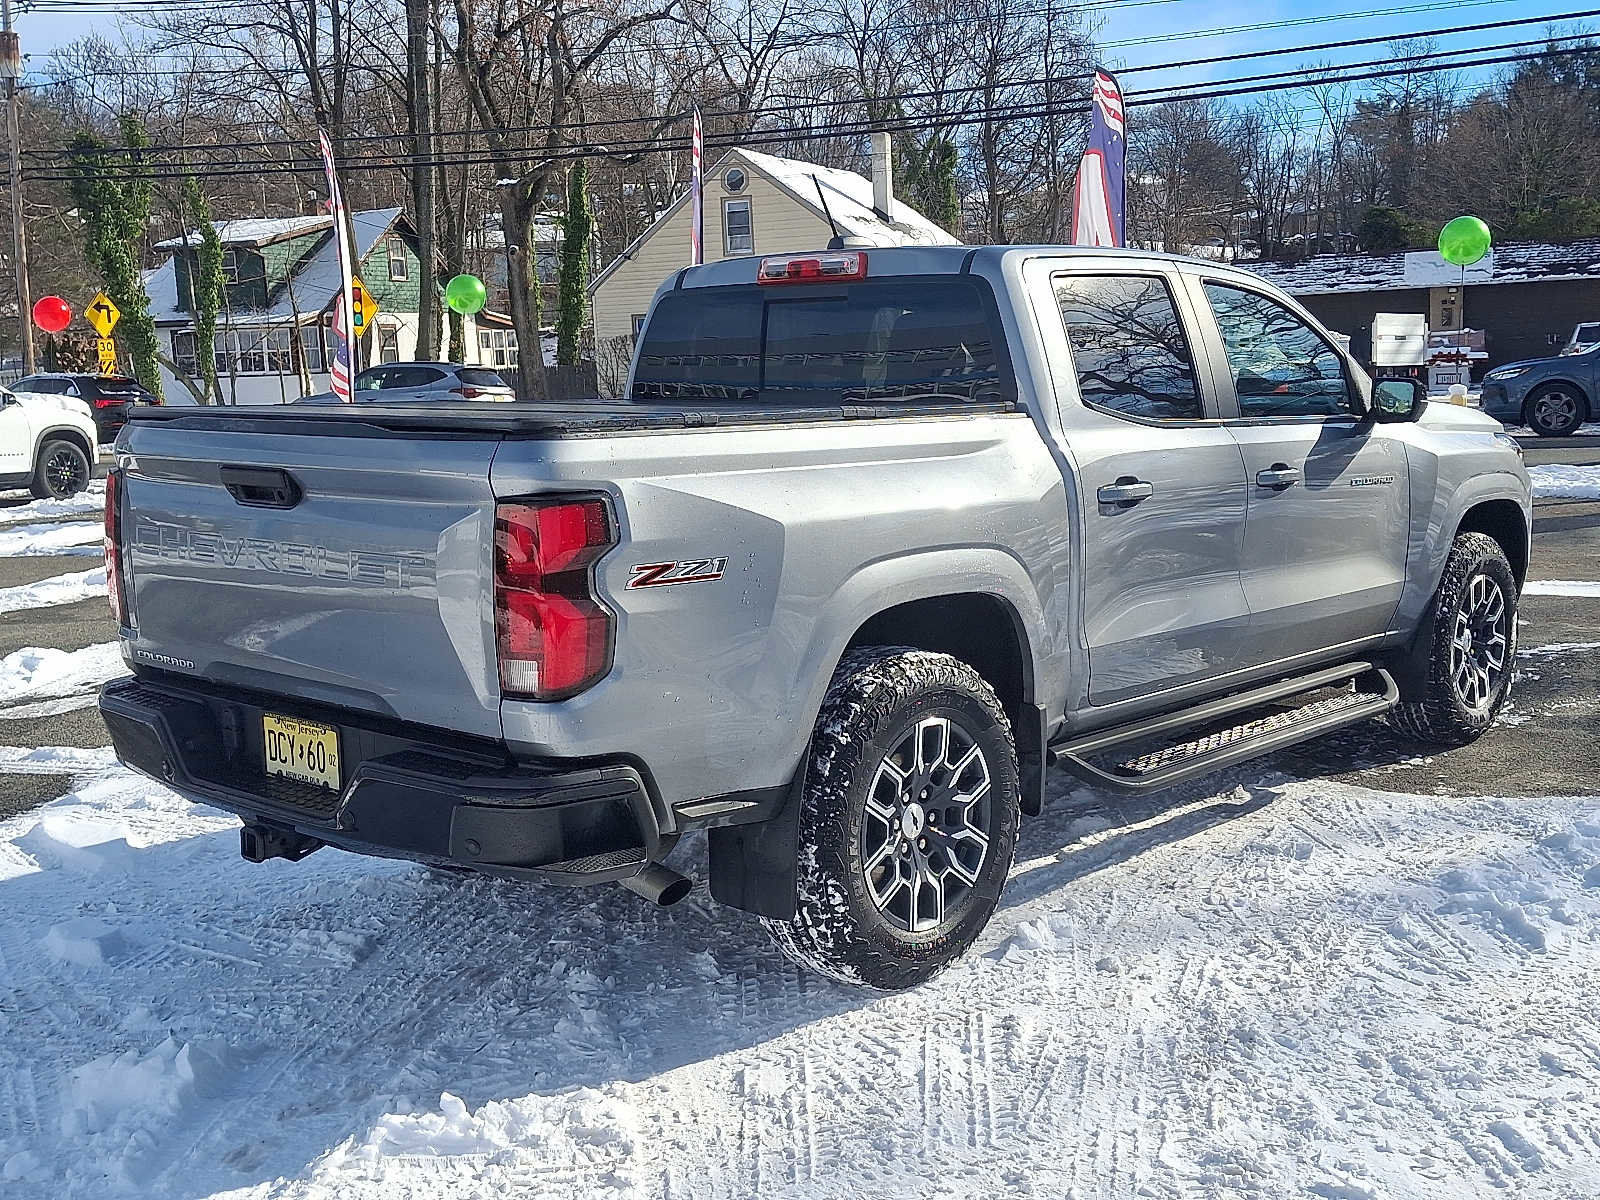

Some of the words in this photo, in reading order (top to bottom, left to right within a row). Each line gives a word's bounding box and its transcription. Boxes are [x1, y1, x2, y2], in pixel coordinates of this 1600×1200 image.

[99, 342, 113, 352] 30
[135, 524, 429, 591] CHEVROLET
[624, 556, 729, 590] Z71
[137, 650, 195, 669] COLORADO
[280, 721, 297, 732] New
[298, 723, 320, 739] Jersey
